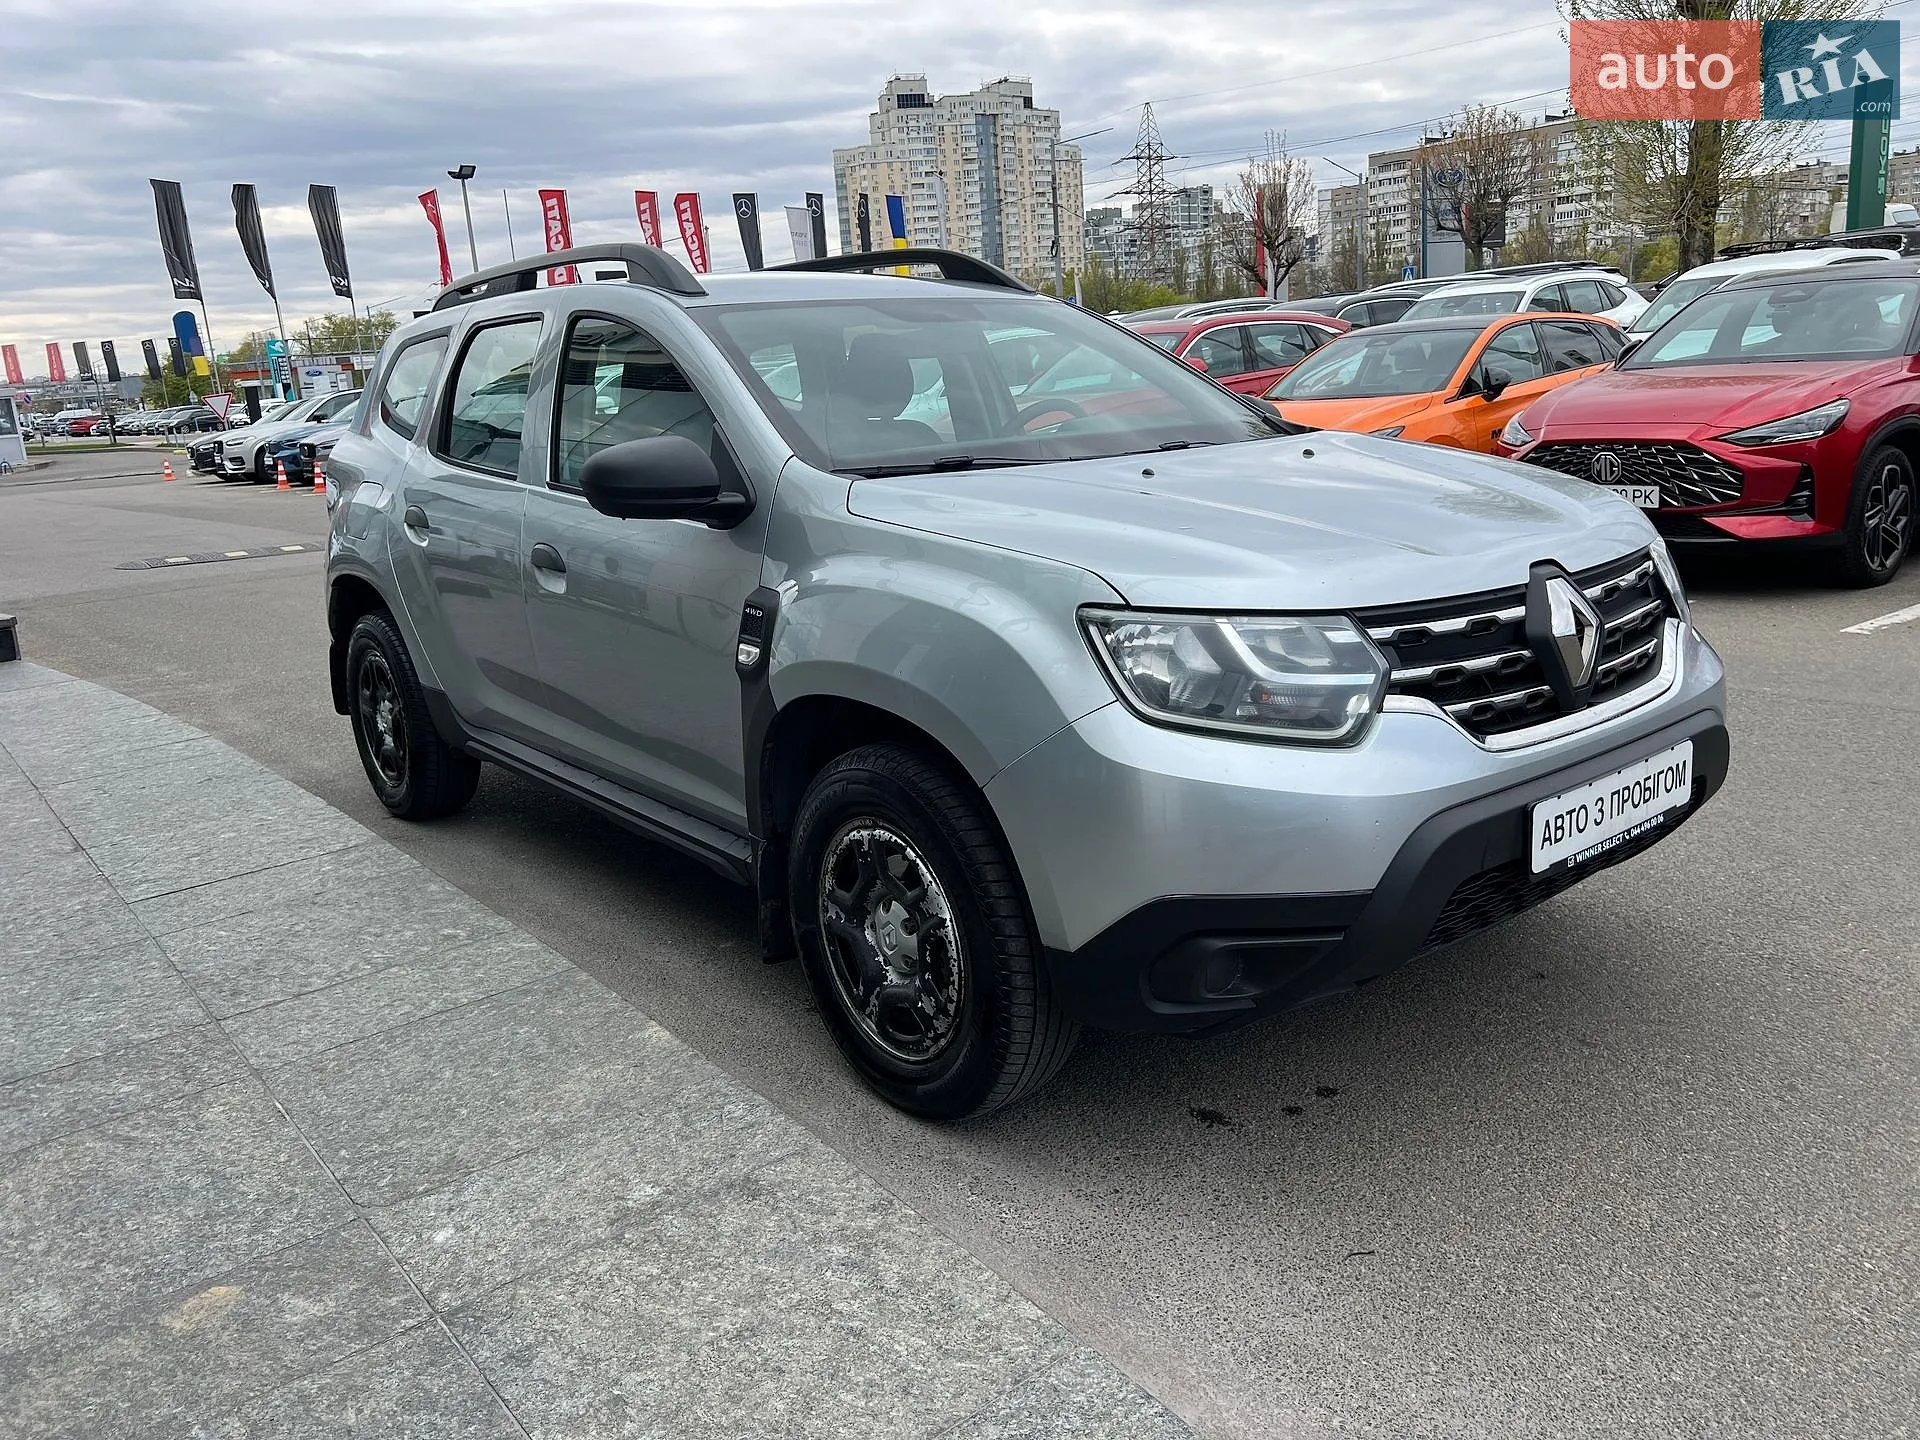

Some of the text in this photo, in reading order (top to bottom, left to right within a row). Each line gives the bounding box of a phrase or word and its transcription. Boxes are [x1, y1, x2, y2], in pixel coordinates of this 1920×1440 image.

[1593, 455, 1618, 481] MG
[745, 607, 763, 617] 4WD
[1540, 760, 1687, 850] АВТО З ПРОБІГОМ
[1576, 843, 1602, 863] WINNER
[1602, 833, 1624, 851] SELECT
